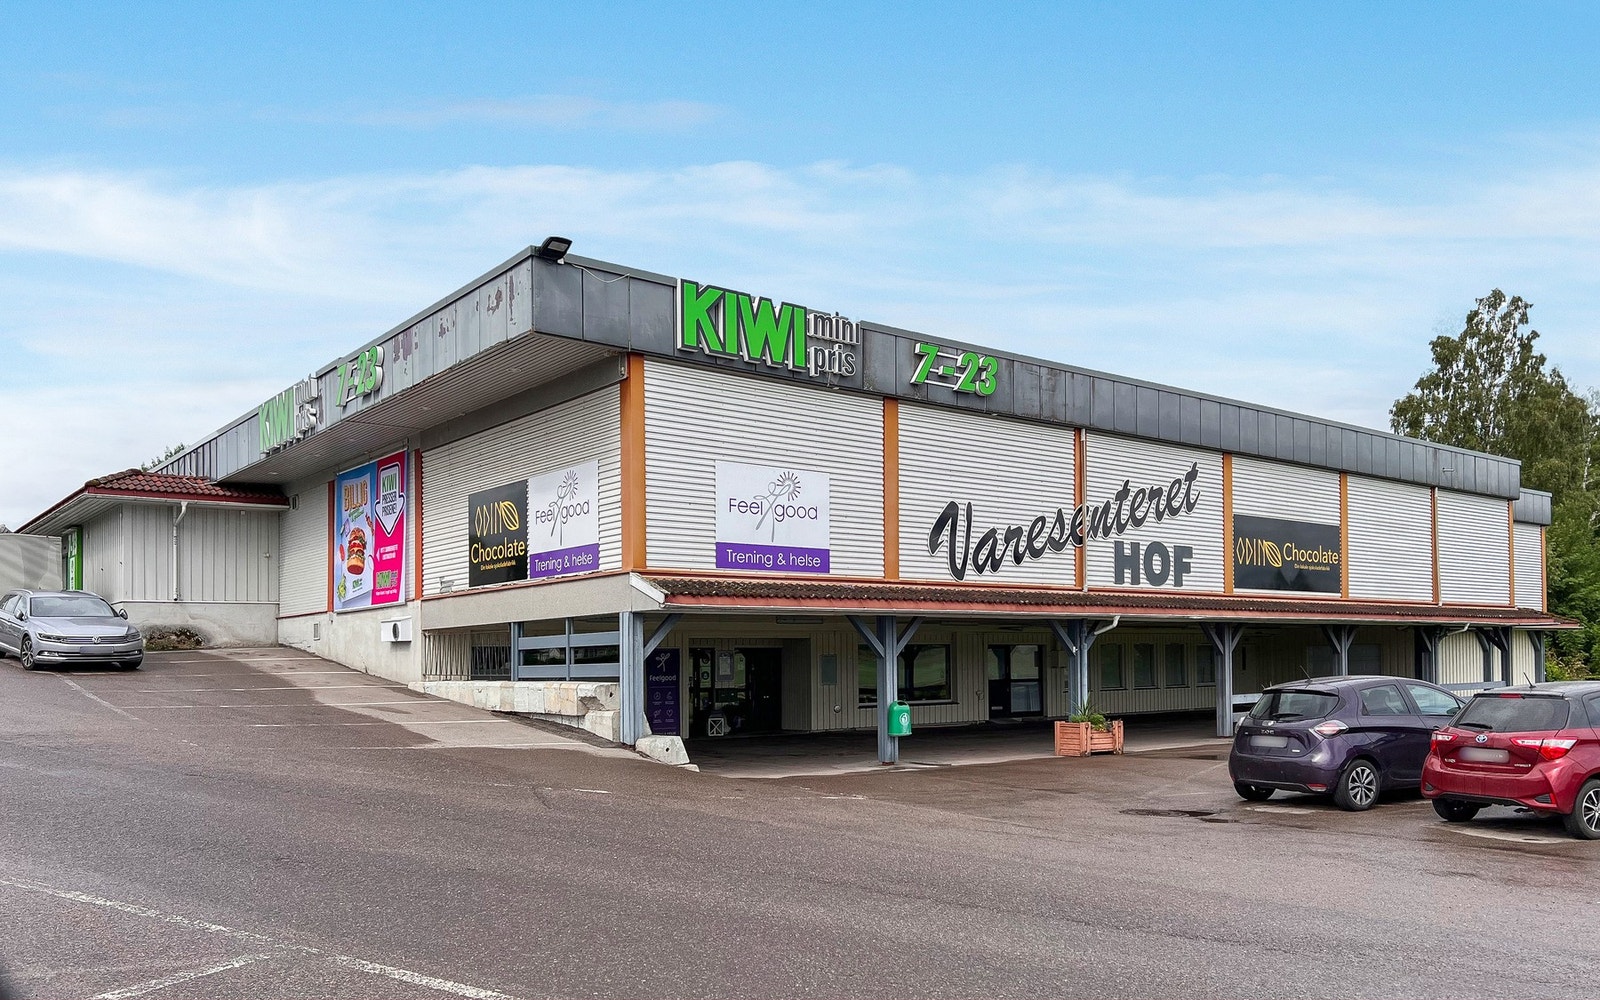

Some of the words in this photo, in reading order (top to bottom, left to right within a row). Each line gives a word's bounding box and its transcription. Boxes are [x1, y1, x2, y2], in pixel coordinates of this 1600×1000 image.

[679, 279, 807, 371] KIWI
[808, 311, 860, 345] mini
[808, 344, 856, 377] pris
[911, 342, 998, 396] 7-23
[259, 388, 295, 455] KIWI
[344, 480, 368, 511] BILLIG
[382, 472, 397, 493] KIWI
[928, 461, 1200, 582] Varesenteret
[470, 537, 526, 564] Chocolate
[534, 557, 562, 572] Trening
[564, 555, 570, 568] &
[571, 552, 593, 566] helse
[726, 549, 773, 568] Trening
[777, 553, 786, 566] &
[789, 553, 821, 568] helse
[1114, 540, 1194, 588] HOF
[1283, 542, 1339, 565] Chocolate
